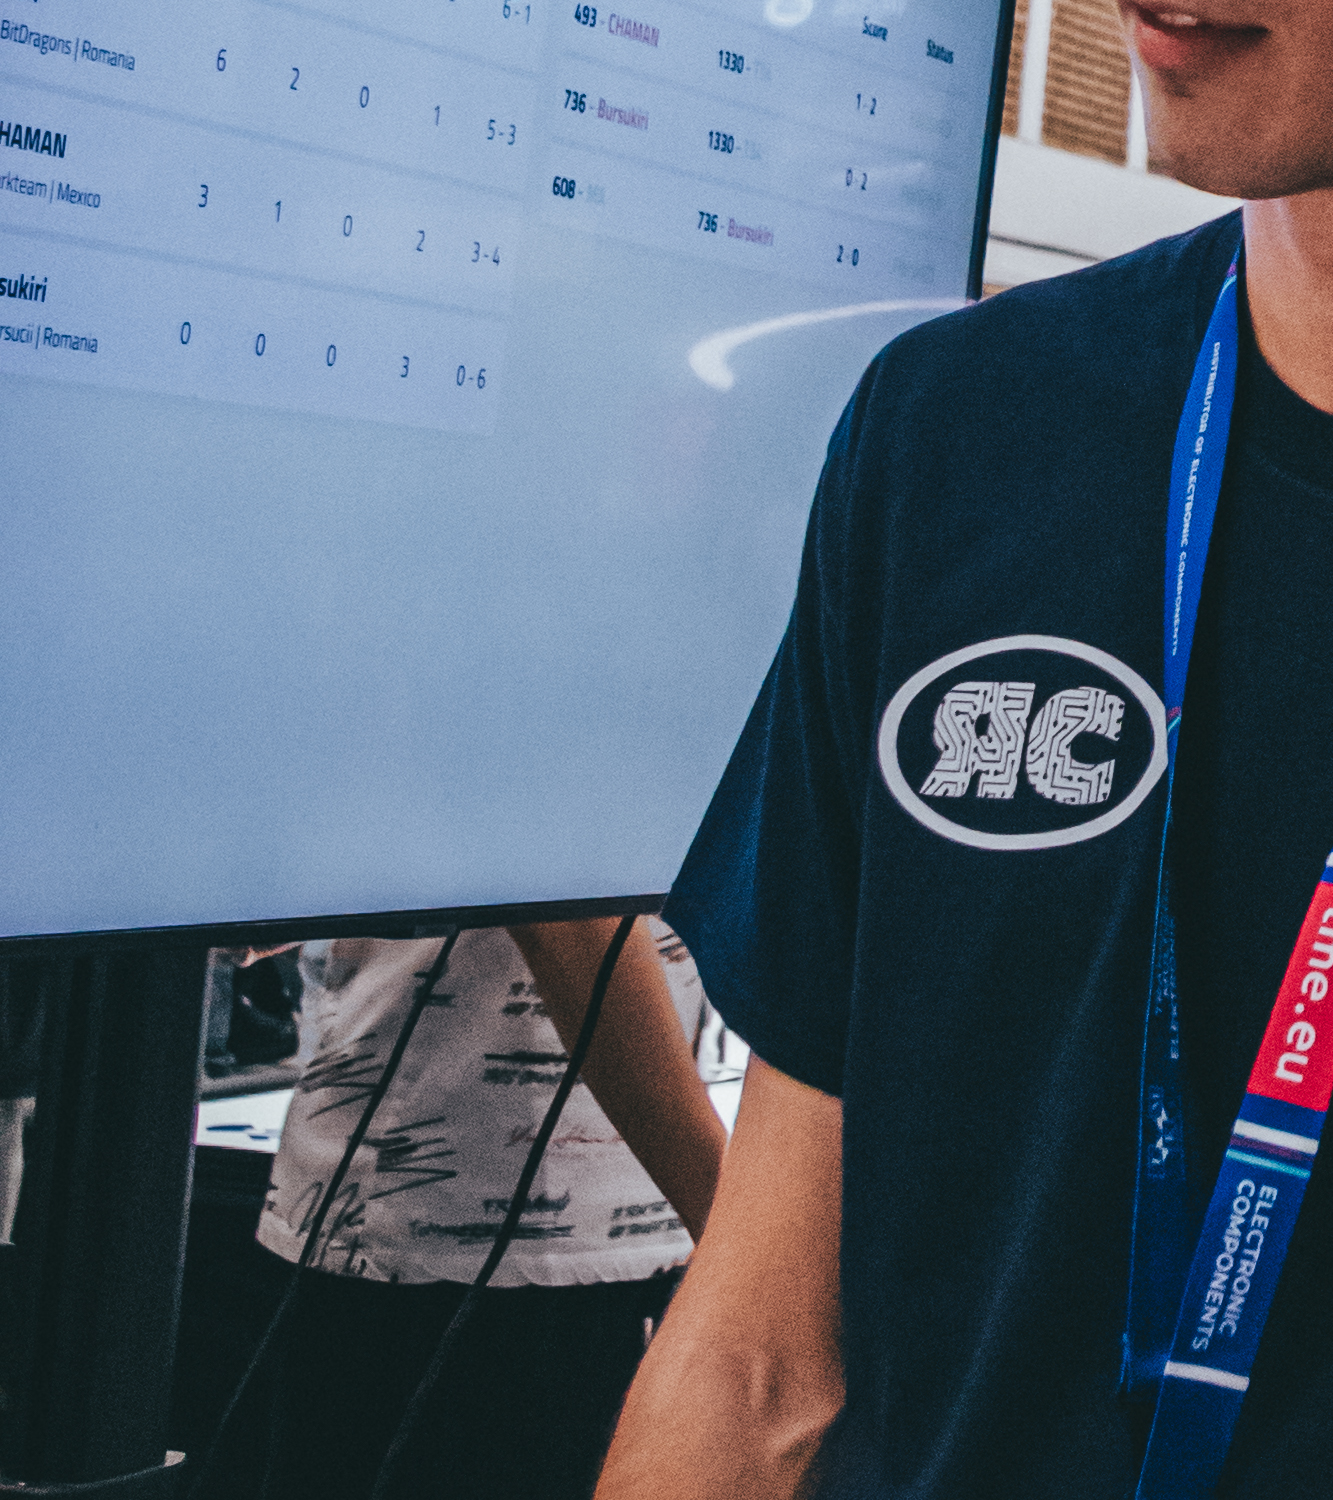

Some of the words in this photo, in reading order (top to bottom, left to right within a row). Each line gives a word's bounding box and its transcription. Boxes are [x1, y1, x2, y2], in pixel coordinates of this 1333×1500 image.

[525, 4, 531, 25] 1
[574, 3, 598, 28] 493
[608, 12, 660, 48] CHAMAN
[0, 19, 72, 56] BitDragons
[81, 40, 136, 71] Romania
[719, 50, 745, 74] 1330
[216, 49, 227, 72] 6
[290, 68, 300, 90] 2
[359, 85, 370, 108] 0
[433, 105, 440, 126] 1
[487, 119, 496, 140] 5
[507, 124, 517, 145] 3
[564, 89, 587, 113] 736
[0, 121, 67, 158] HAMAN
[708, 130, 735, 154] 1330
[57, 181, 101, 208] Mexico
[552, 175, 576, 199] 608
[198, 184, 209, 208] 3
[275, 200, 282, 223] 1
[343, 215, 353, 237] 0
[416, 230, 425, 252] 2
[471, 242, 481, 263] 3
[492, 247, 500, 266] 4
[698, 210, 719, 233] 736
[43, 326, 98, 353] Romania
[180, 321, 192, 345] 0
[255, 333, 266, 356] 0
[326, 344, 337, 367] 0
[400, 356, 410, 378] 3
[456, 365, 465, 386] 0
[477, 368, 486, 389] 6
[1199, 341, 1220, 432] DISTRIBUTOR
[1195, 435, 1205, 454] OF
[1180, 459, 1199, 548] ELECTRONIC
[1192, 1180, 1255, 1351] COMPONENTS
[1219, 1186, 1278, 1337] ELECTRONIC
